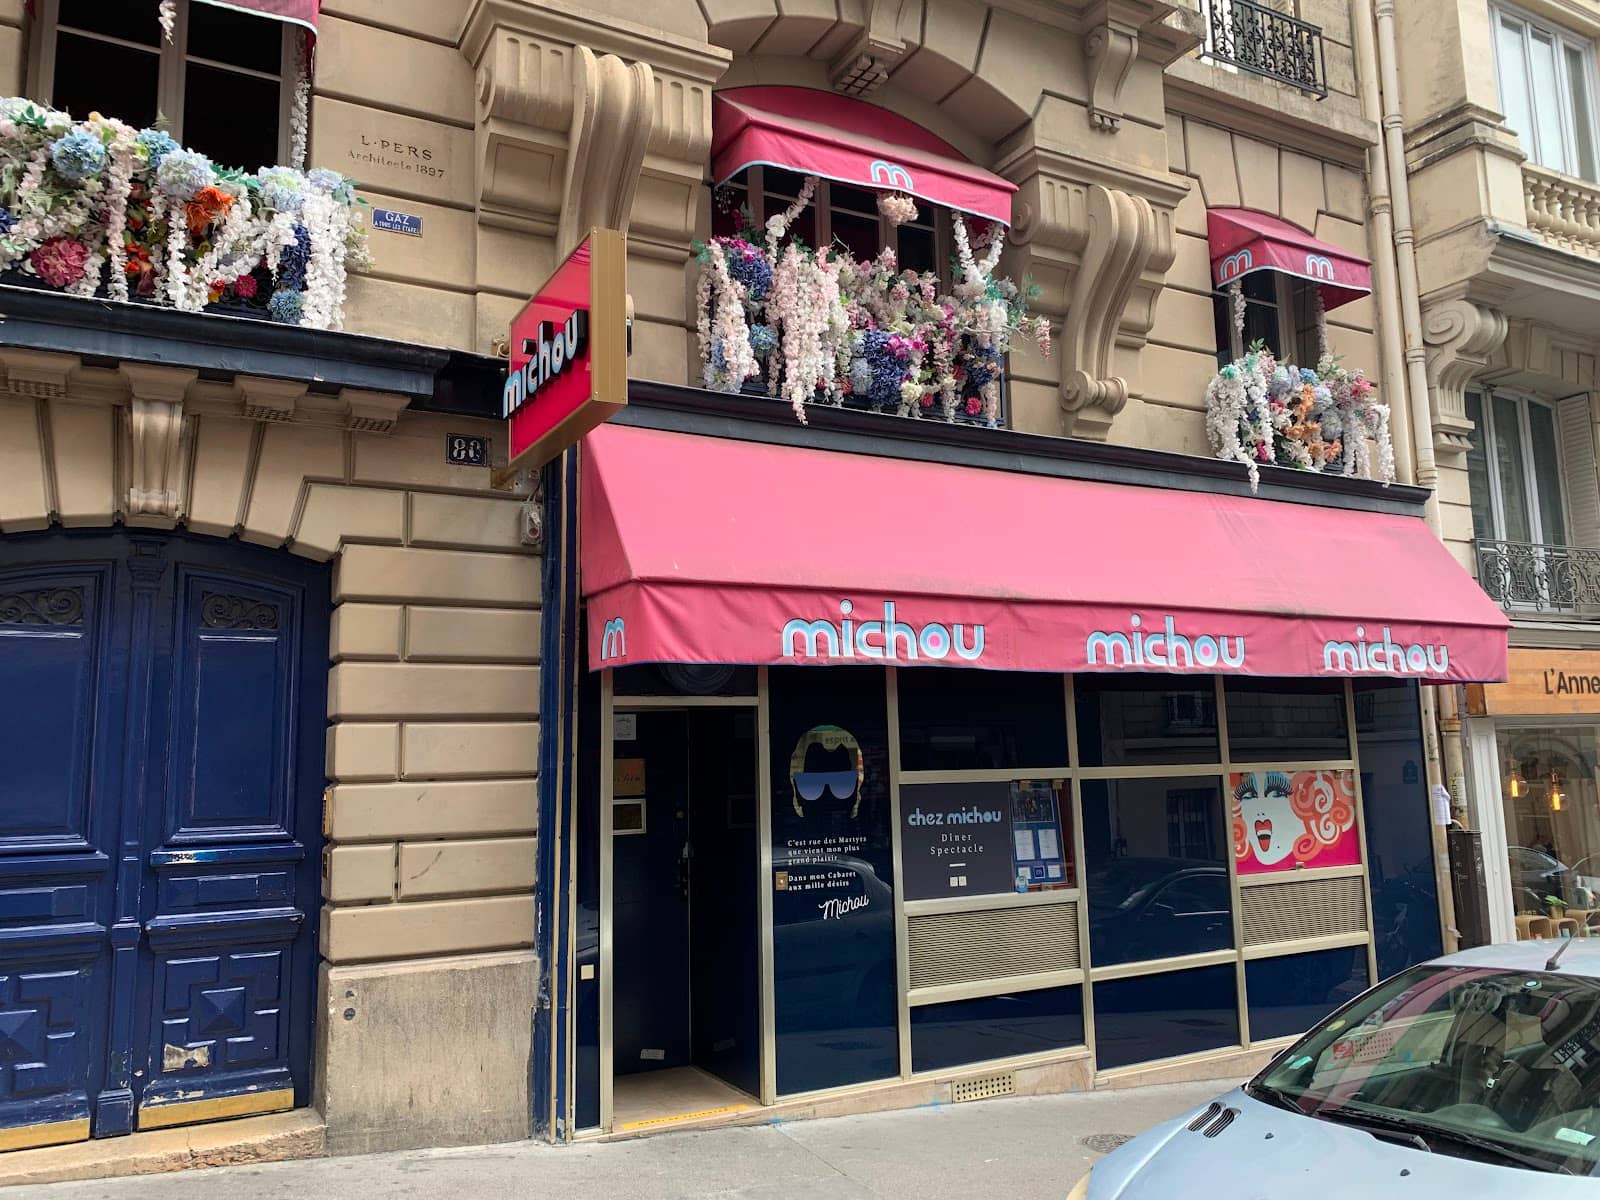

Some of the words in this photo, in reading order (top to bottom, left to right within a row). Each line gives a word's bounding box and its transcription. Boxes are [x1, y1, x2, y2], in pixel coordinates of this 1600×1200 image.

[416, 164, 445, 178] 1897
[385, 212, 410, 225] GAZ
[503, 311, 580, 419] michou
[782, 600, 985, 659] michou
[1086, 614, 1246, 668] michou
[1323, 625, 1449, 674] michou
[908, 808, 943, 825] chez
[946, 806, 1002, 825] michou
[823, 836, 836, 844] des
[844, 844, 860, 853] plus
[930, 843, 984, 857] Spectacle
[827, 871, 857, 879] Cabaret
[818, 894, 870, 920] Michou
